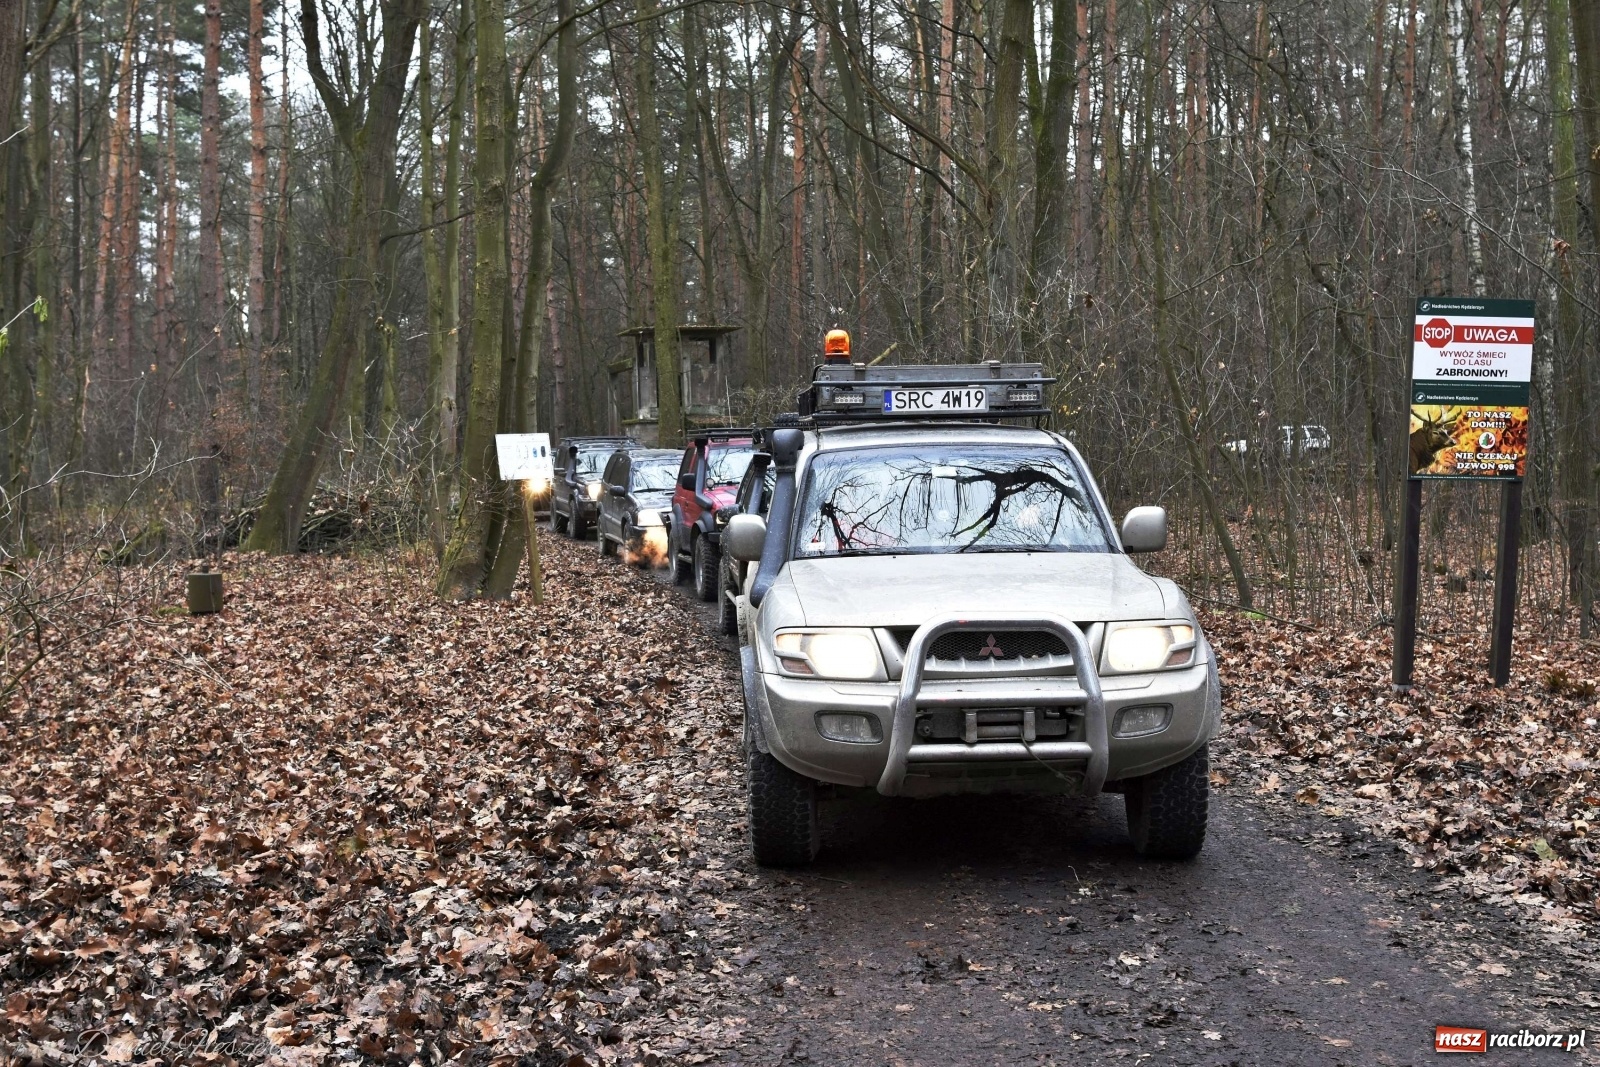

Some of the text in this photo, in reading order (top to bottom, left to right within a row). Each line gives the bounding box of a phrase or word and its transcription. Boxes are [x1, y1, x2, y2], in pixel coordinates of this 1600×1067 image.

[1424, 327, 1451, 339] STOP
[1463, 328, 1519, 342] UWAGA
[1439, 350, 1506, 359] WYWÓZ ŚMIECI
[1436, 368, 1508, 378] ZABRONIONY!
[894, 390, 984, 409] SRC 4W19
[1483, 411, 1512, 419] NASZ
[1471, 421, 1506, 429] DOM!!!
[1455, 452, 1518, 461] NIE CZEKAJ
[1457, 462, 1515, 471] DZWOŃ 998
